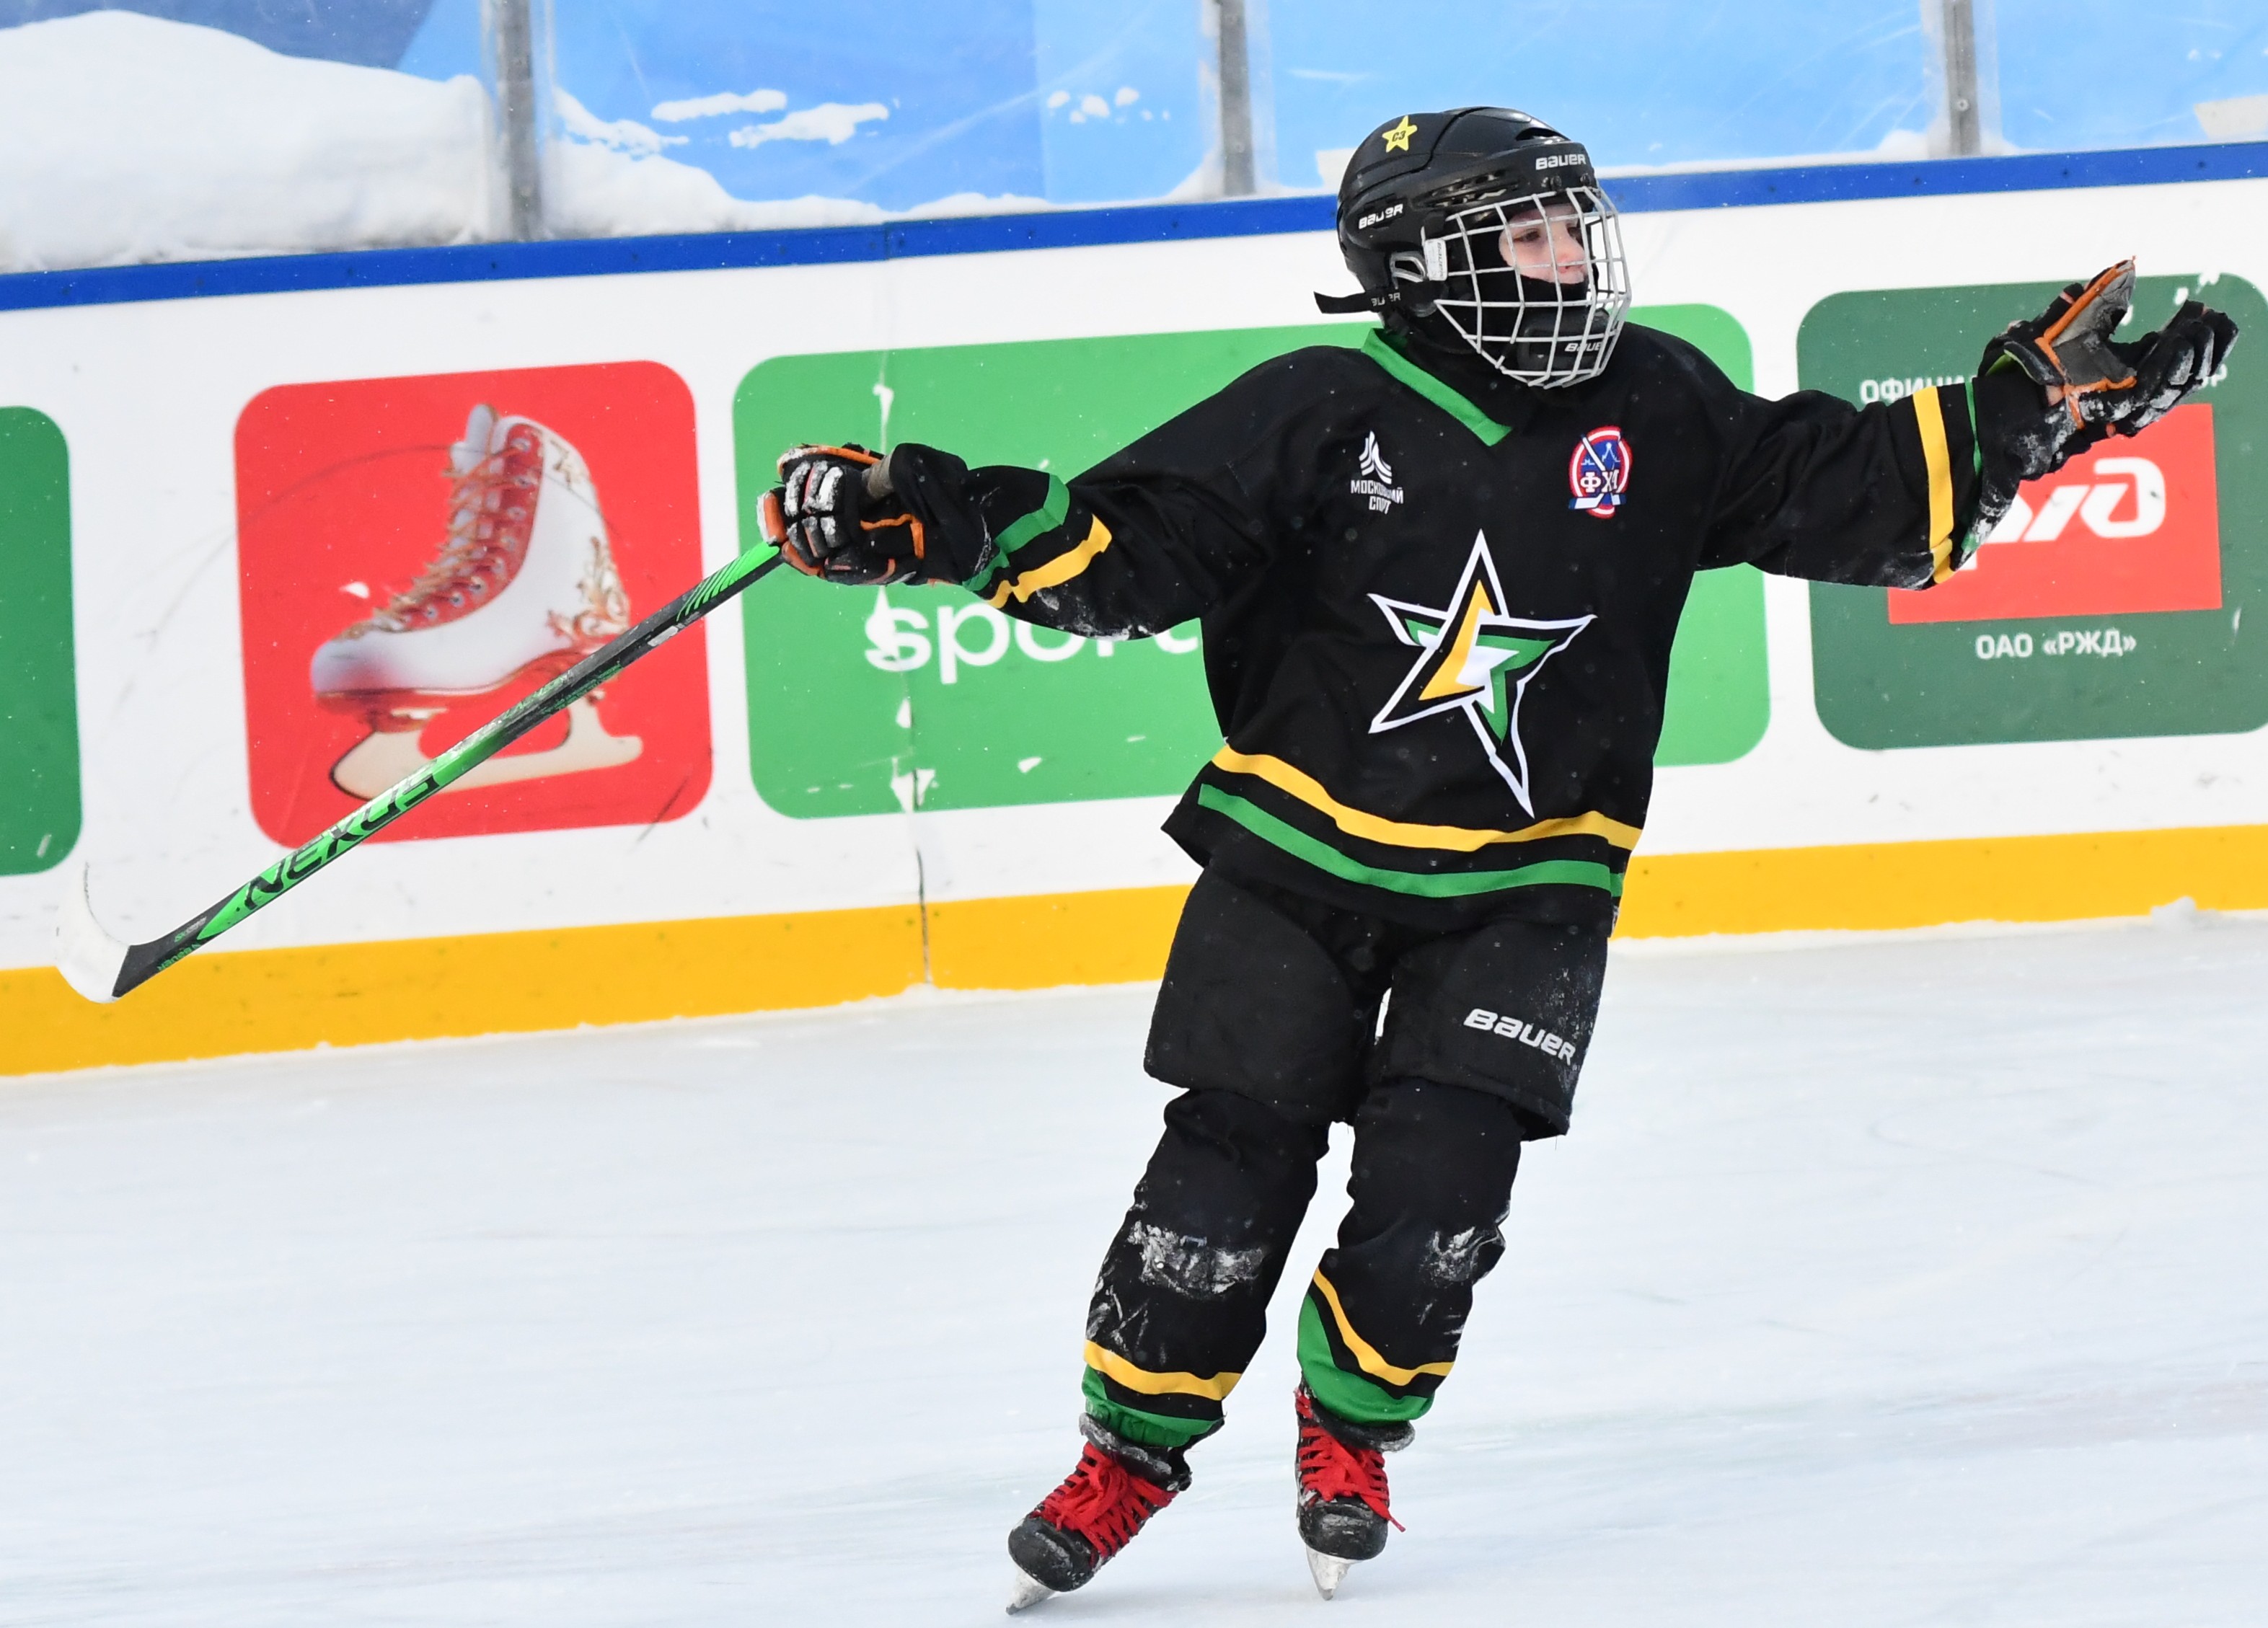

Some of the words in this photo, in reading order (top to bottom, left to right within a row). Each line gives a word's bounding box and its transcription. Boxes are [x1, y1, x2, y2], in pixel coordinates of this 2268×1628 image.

[1535, 153, 1587, 171] BAUER
[1359, 203, 1404, 230] BAUER
[1975, 632, 2034, 660] ОАО
[2042, 627, 2137, 658] «РЖД»
[243, 761, 441, 911] NEXUS
[1462, 1008, 1576, 1066] BAUER
